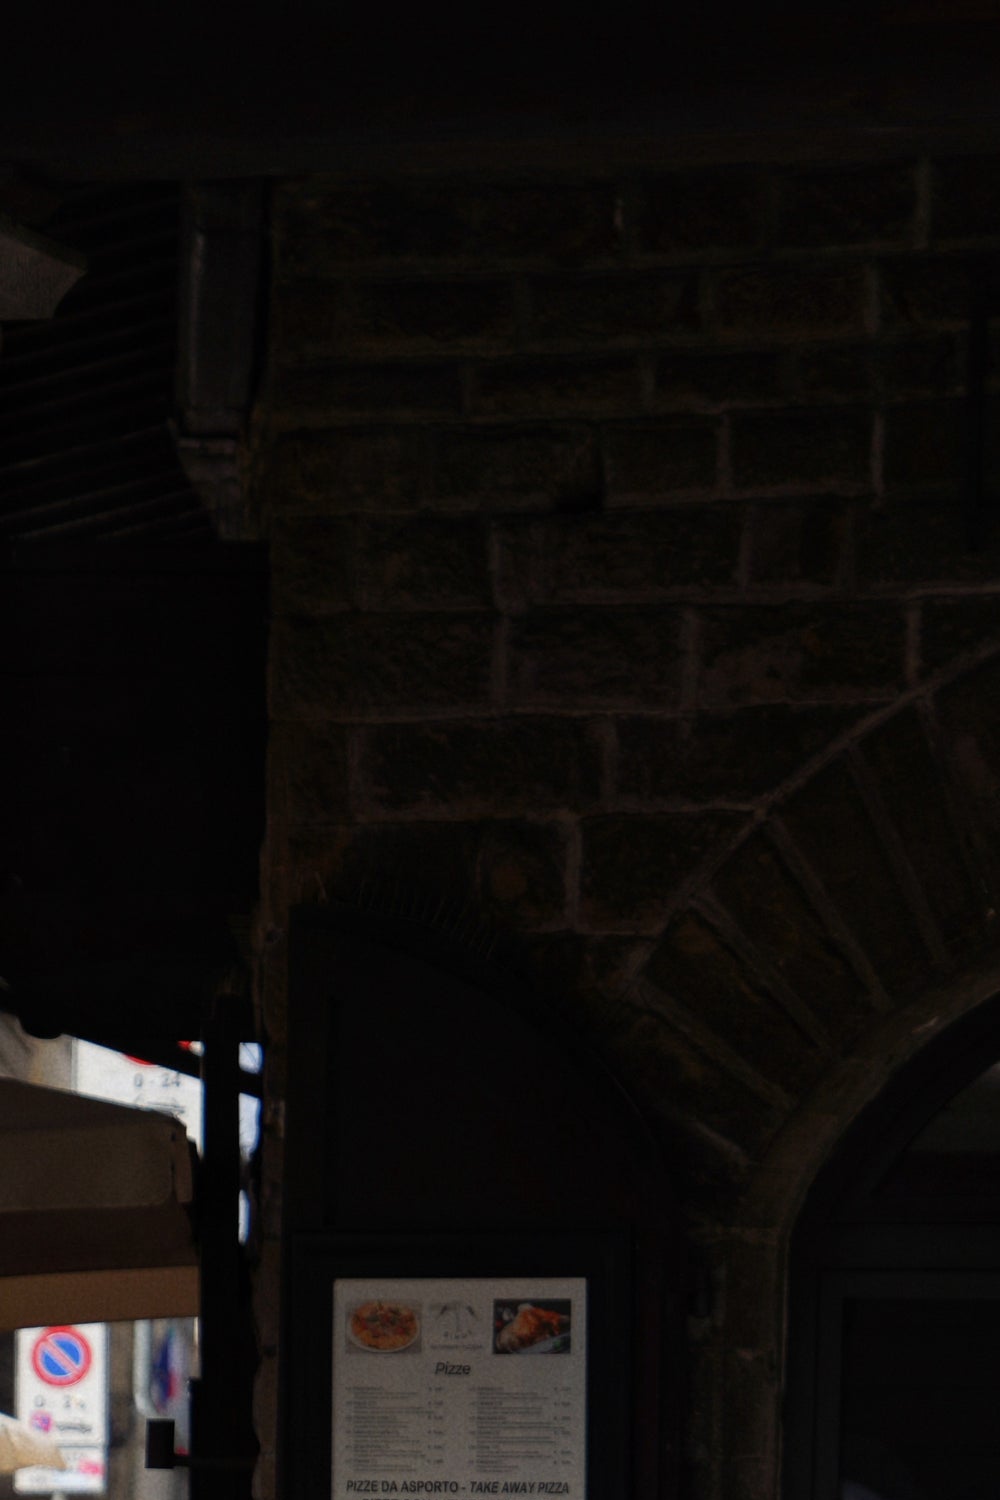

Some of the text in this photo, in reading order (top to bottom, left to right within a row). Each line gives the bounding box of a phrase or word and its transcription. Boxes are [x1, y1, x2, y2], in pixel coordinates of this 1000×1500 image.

[435, 1361, 471, 1375] Pizze
[346, 1480, 378, 1492] PIZZE
[381, 1481, 398, 1493] DA
[401, 1481, 459, 1493] ASPORTO
[470, 1481, 499, 1493] TAKE
[501, 1481, 535, 1493] AWAY
[538, 1482, 569, 1494] PIZZA
